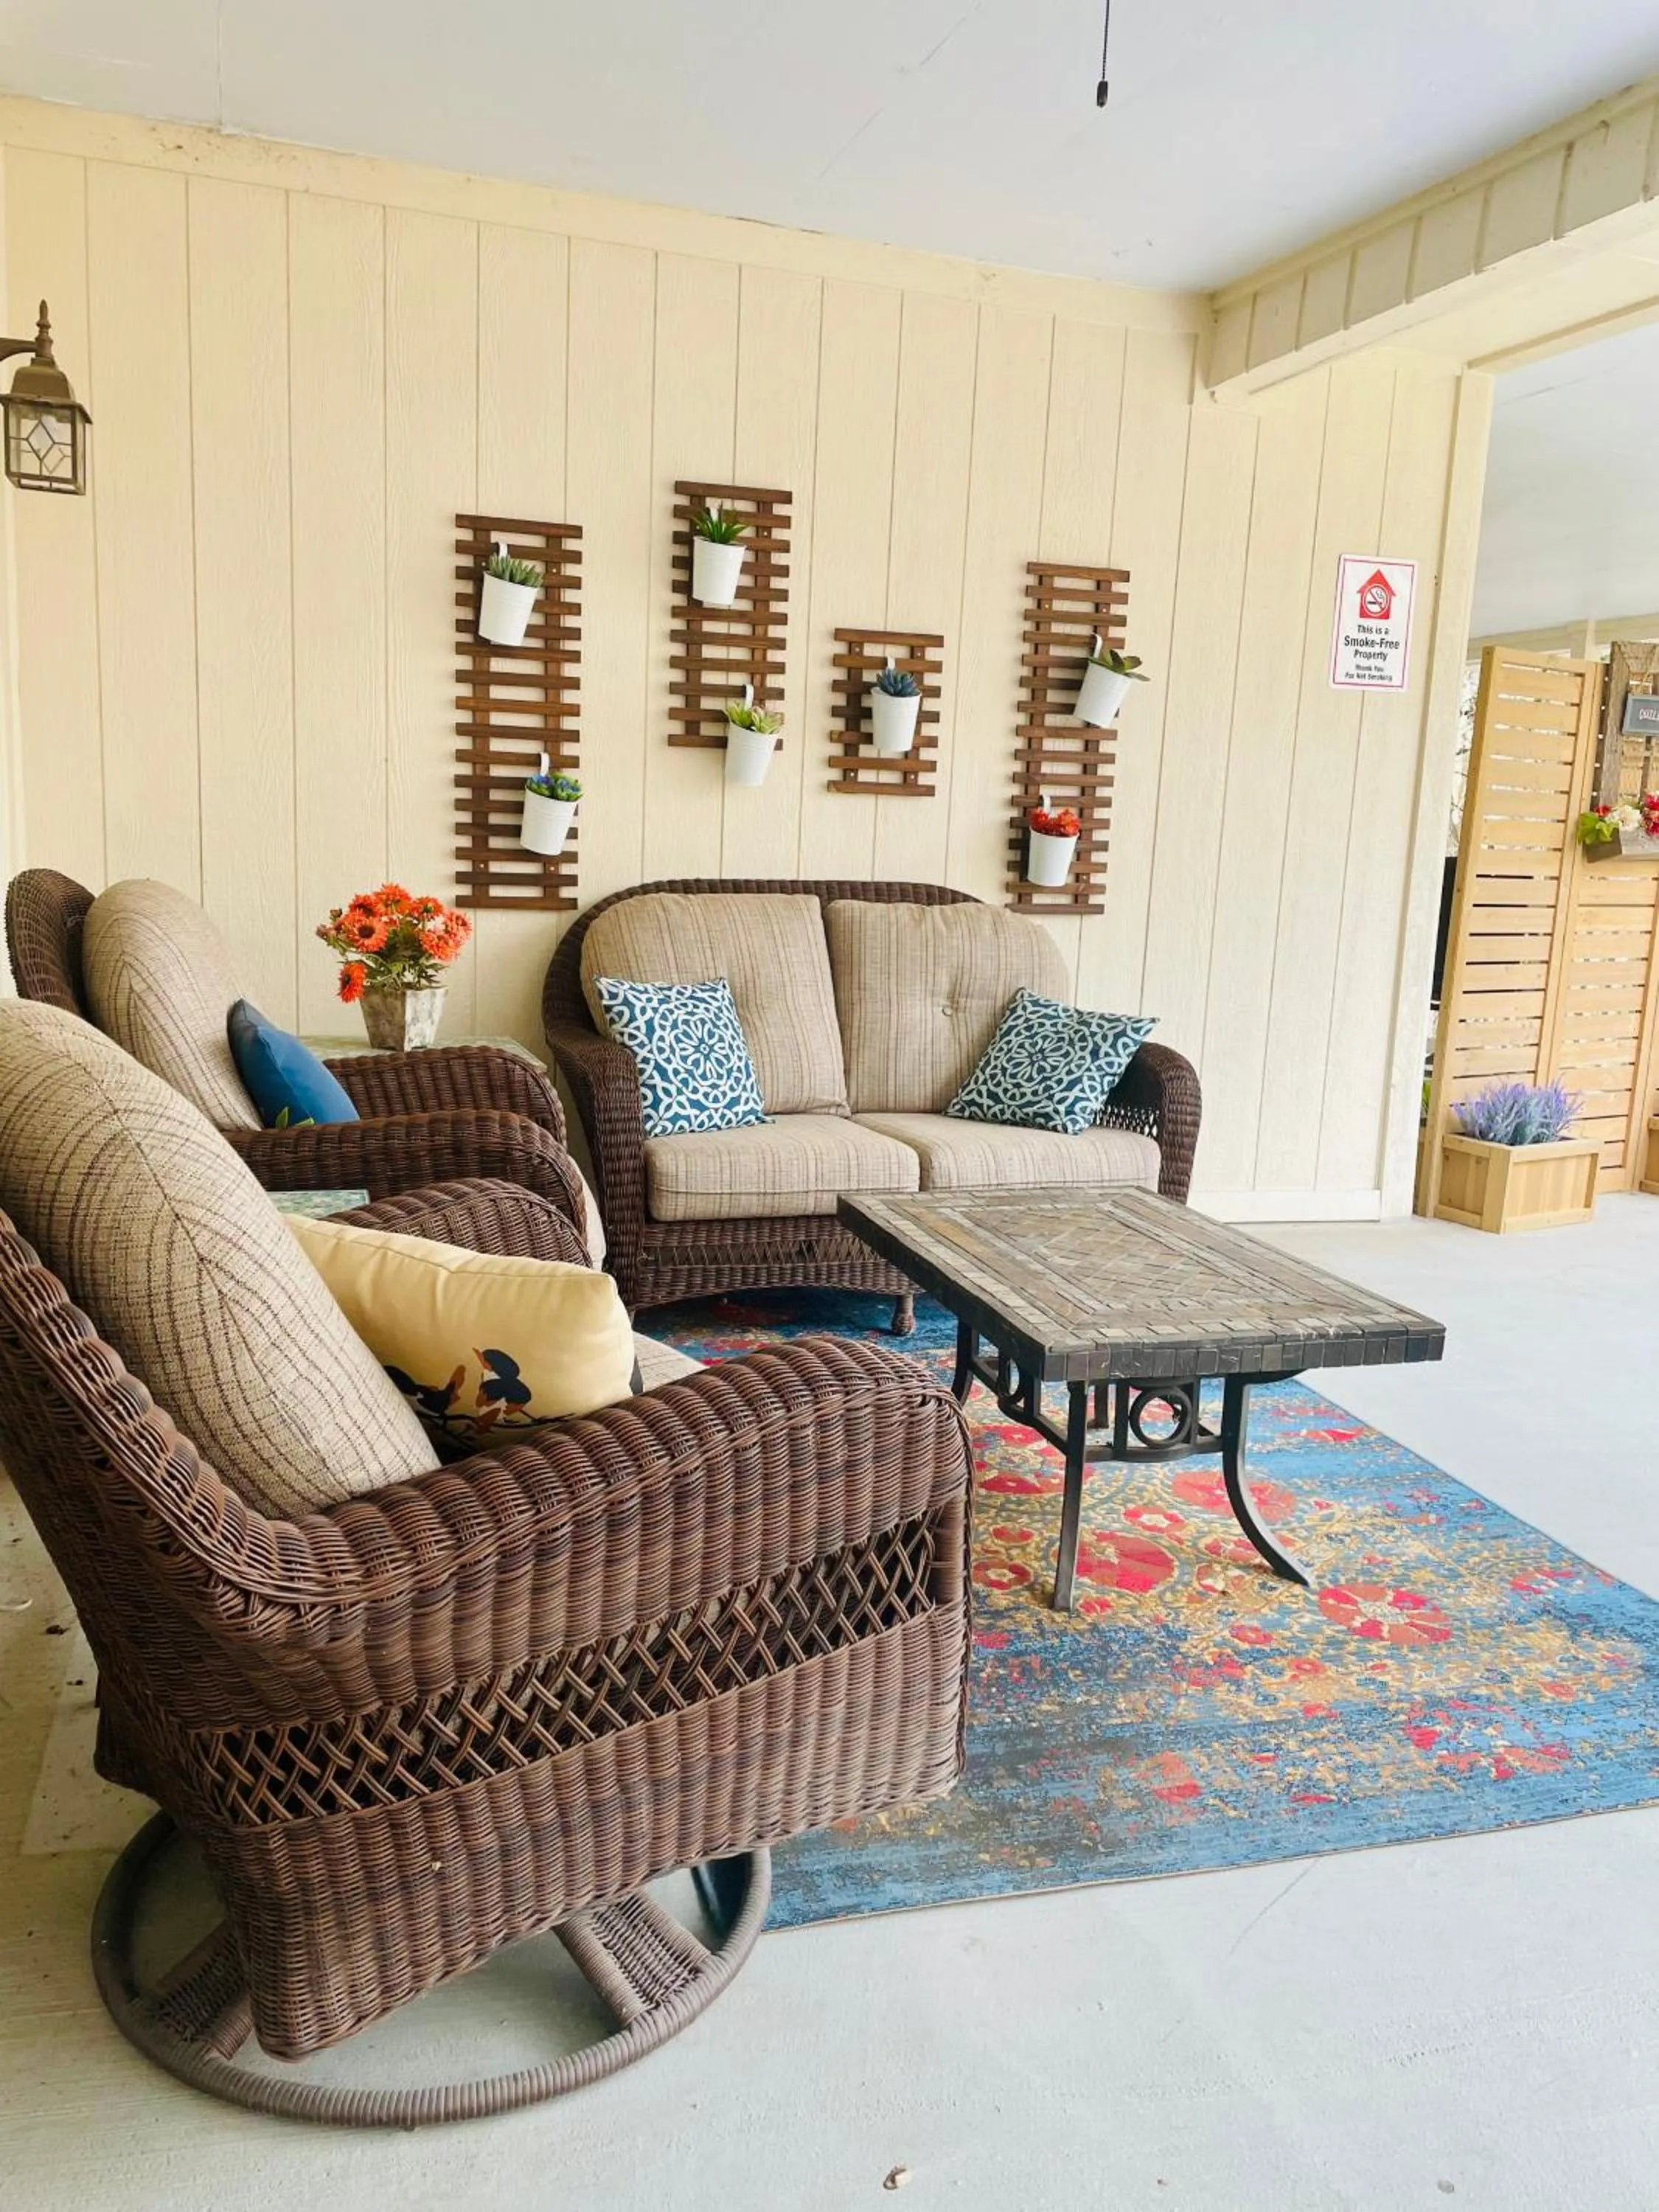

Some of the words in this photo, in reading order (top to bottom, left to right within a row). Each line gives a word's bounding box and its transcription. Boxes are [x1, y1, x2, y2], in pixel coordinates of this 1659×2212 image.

[1357, 625, 1373, 634] This
[1375, 625, 1382, 634] is
[1344, 635, 1400, 649] Smoke-Free
[1354, 649, 1388, 661] Property
